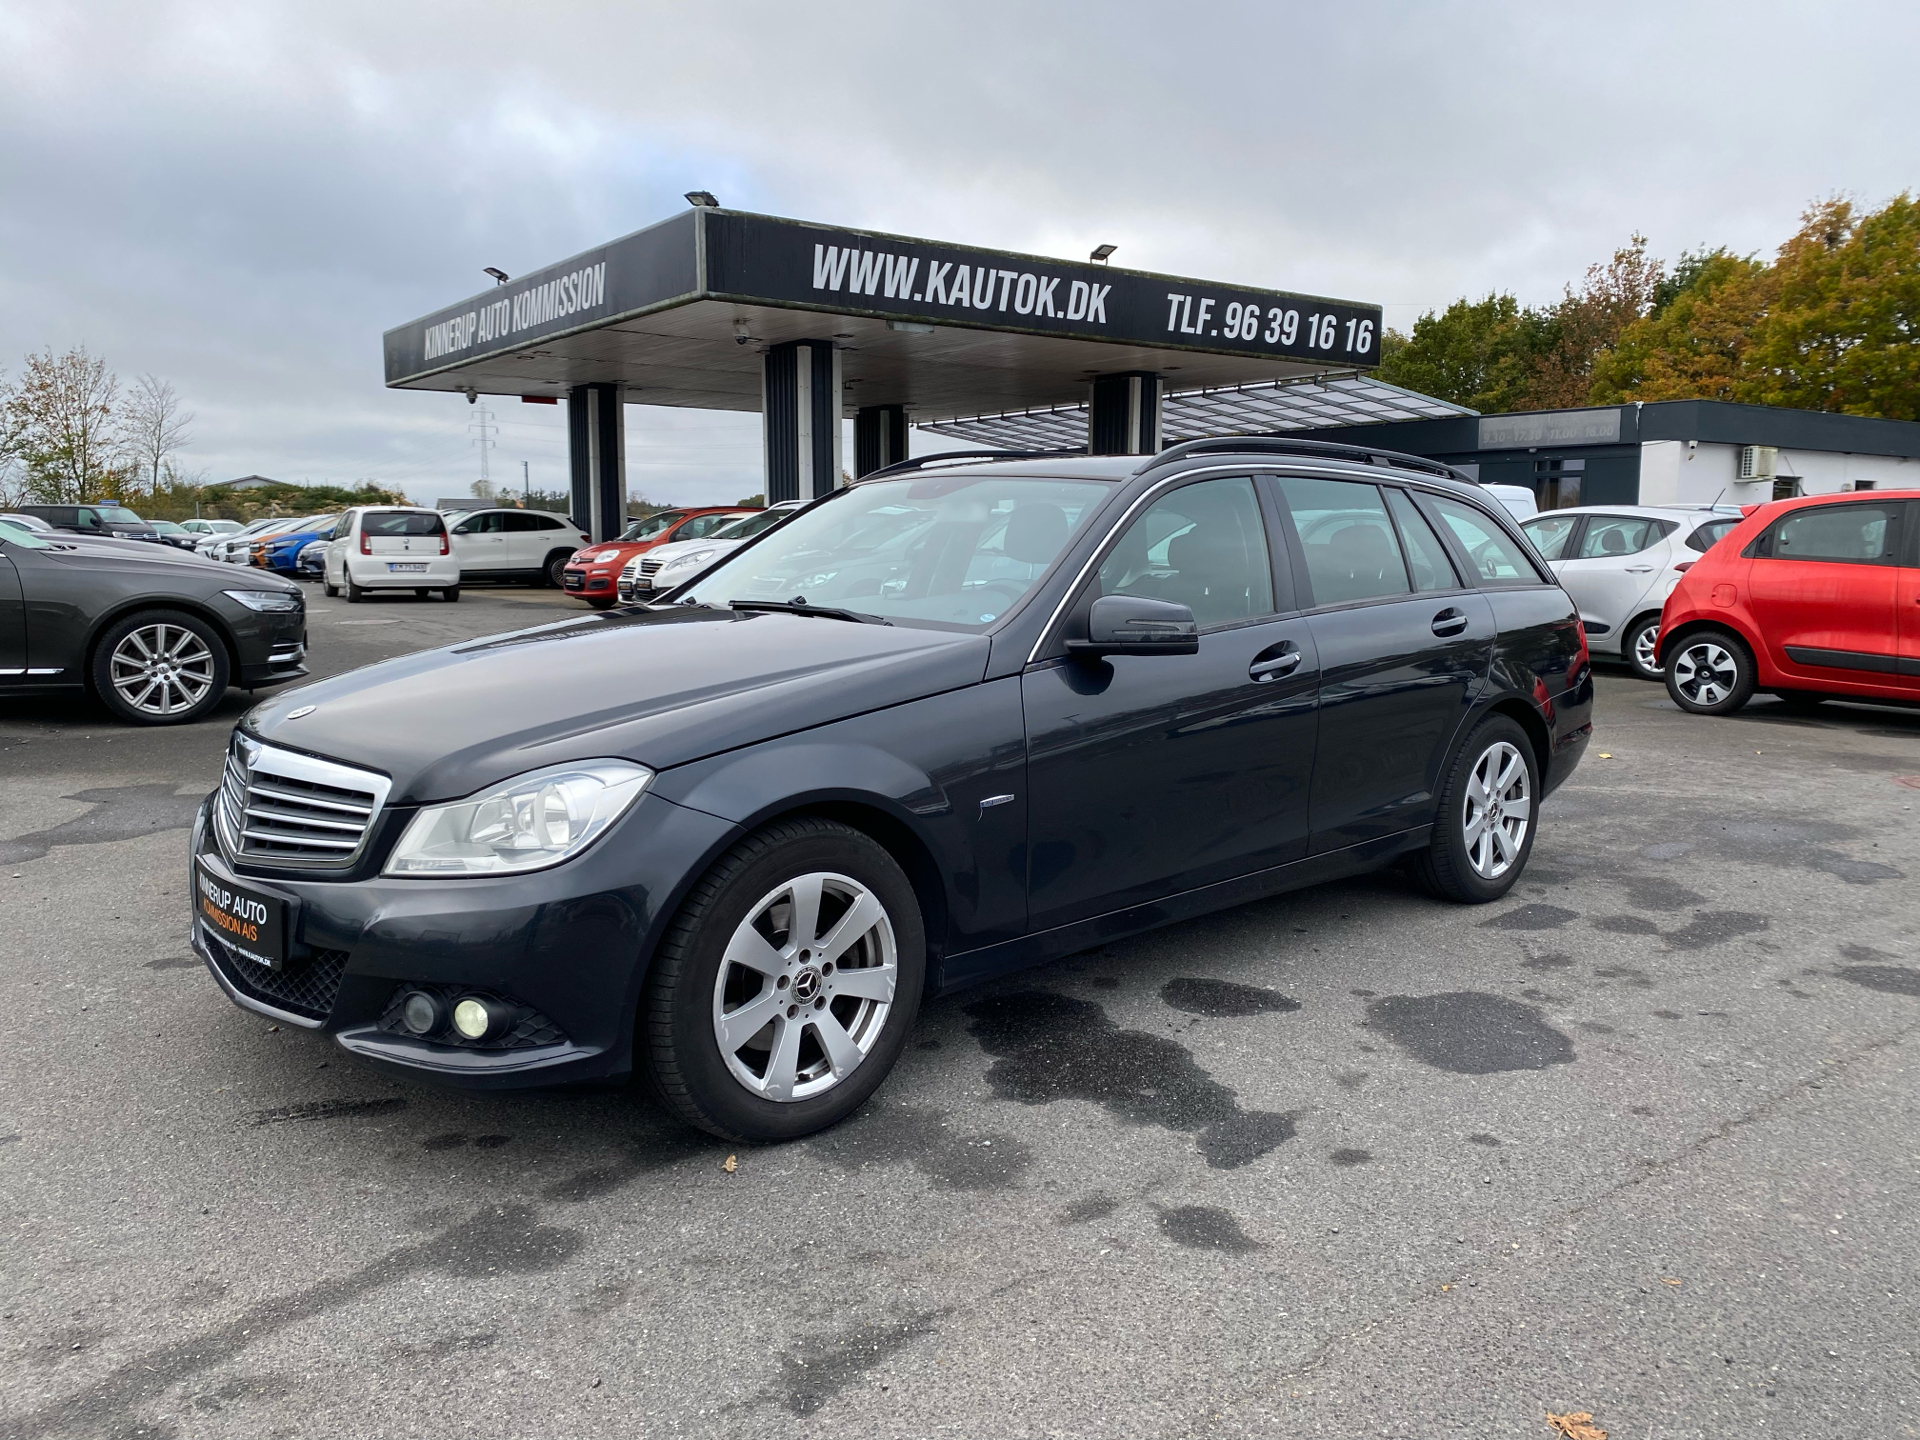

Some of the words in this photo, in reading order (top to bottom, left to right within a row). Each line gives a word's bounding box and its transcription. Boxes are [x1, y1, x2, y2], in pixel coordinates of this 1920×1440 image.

[425, 311, 477, 361] KINNERUP
[477, 298, 510, 343] AUTO
[512, 262, 605, 333] KOMMISSION
[812, 244, 1112, 324] WWW.KAUTOK.DK
[1167, 293, 1217, 338] TLF.
[1224, 301, 1259, 341] 96
[1264, 307, 1299, 346] 39
[1308, 313, 1337, 351] 16
[1346, 318, 1374, 353] 16
[232, 896, 267, 925] AUTO
[242, 922, 258, 942] A/S
